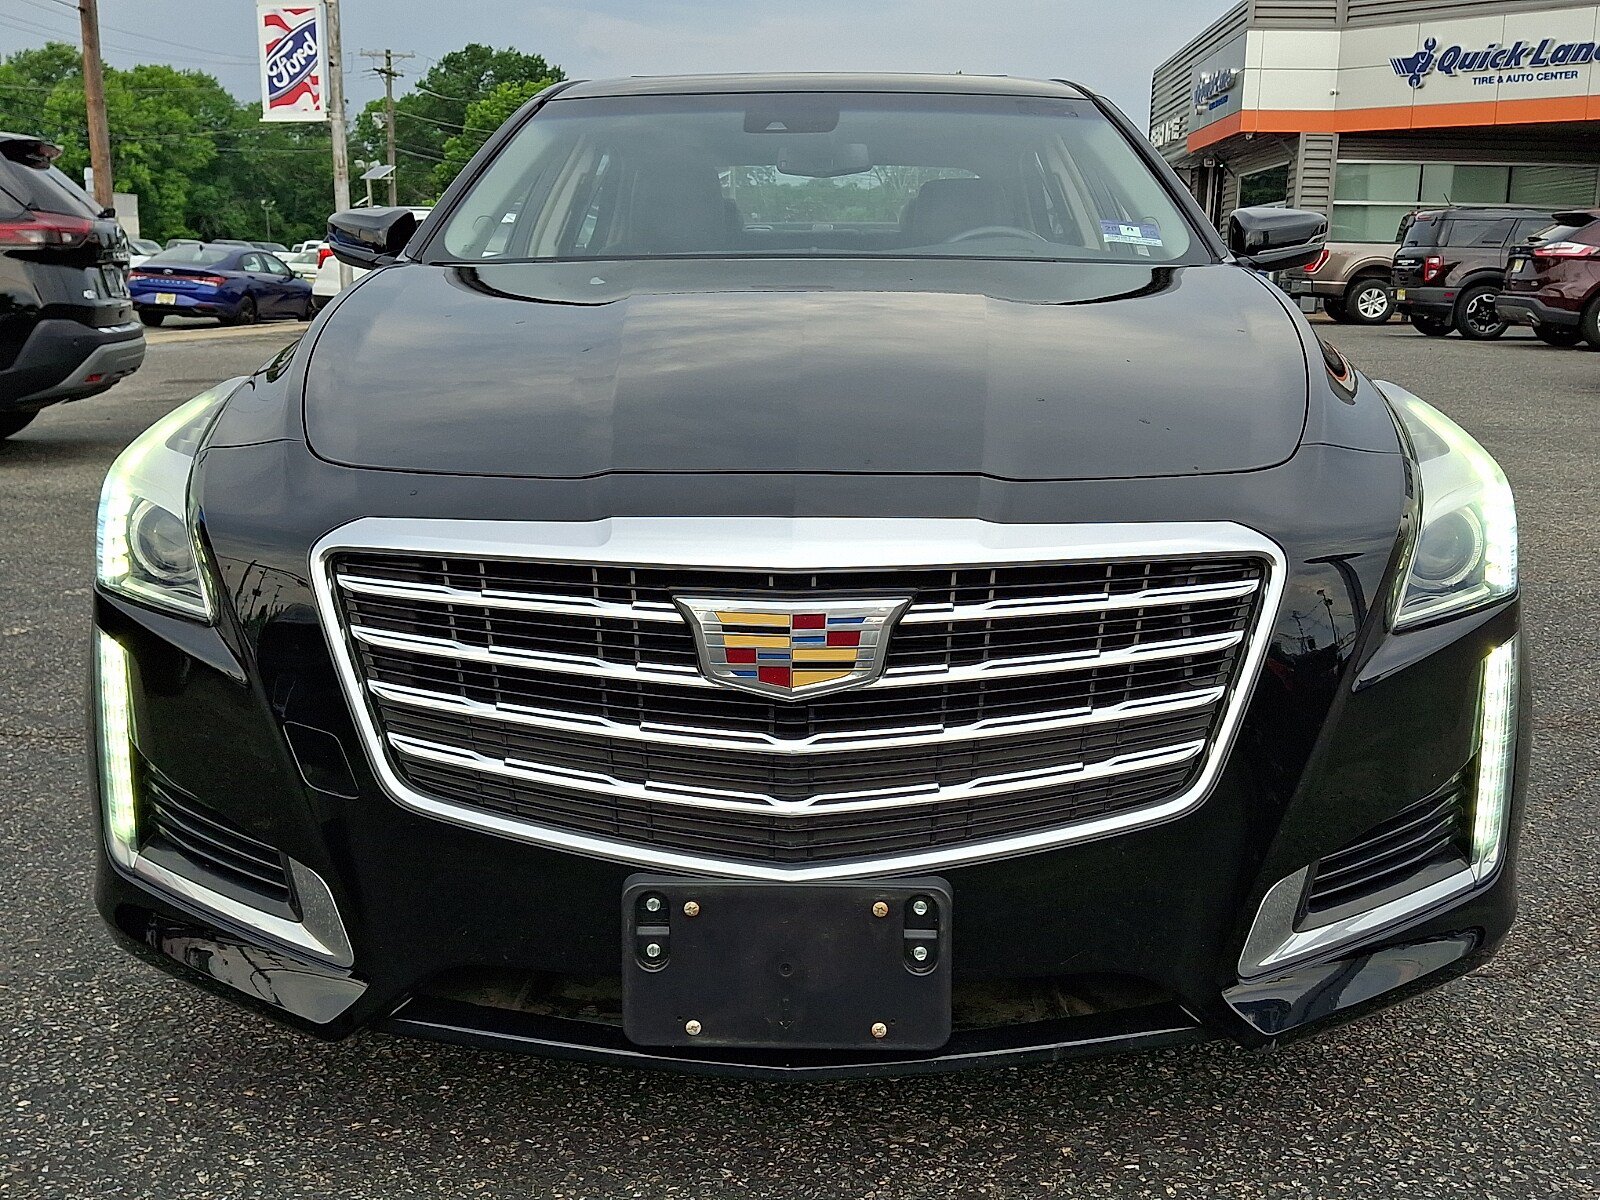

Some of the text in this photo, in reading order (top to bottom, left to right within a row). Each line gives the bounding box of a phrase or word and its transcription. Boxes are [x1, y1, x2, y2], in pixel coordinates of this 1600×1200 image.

[267, 31, 317, 88] Ford
[1437, 41, 1529, 75] Quick
[1472, 70, 1579, 85] TIRE & AUTO CENTER
